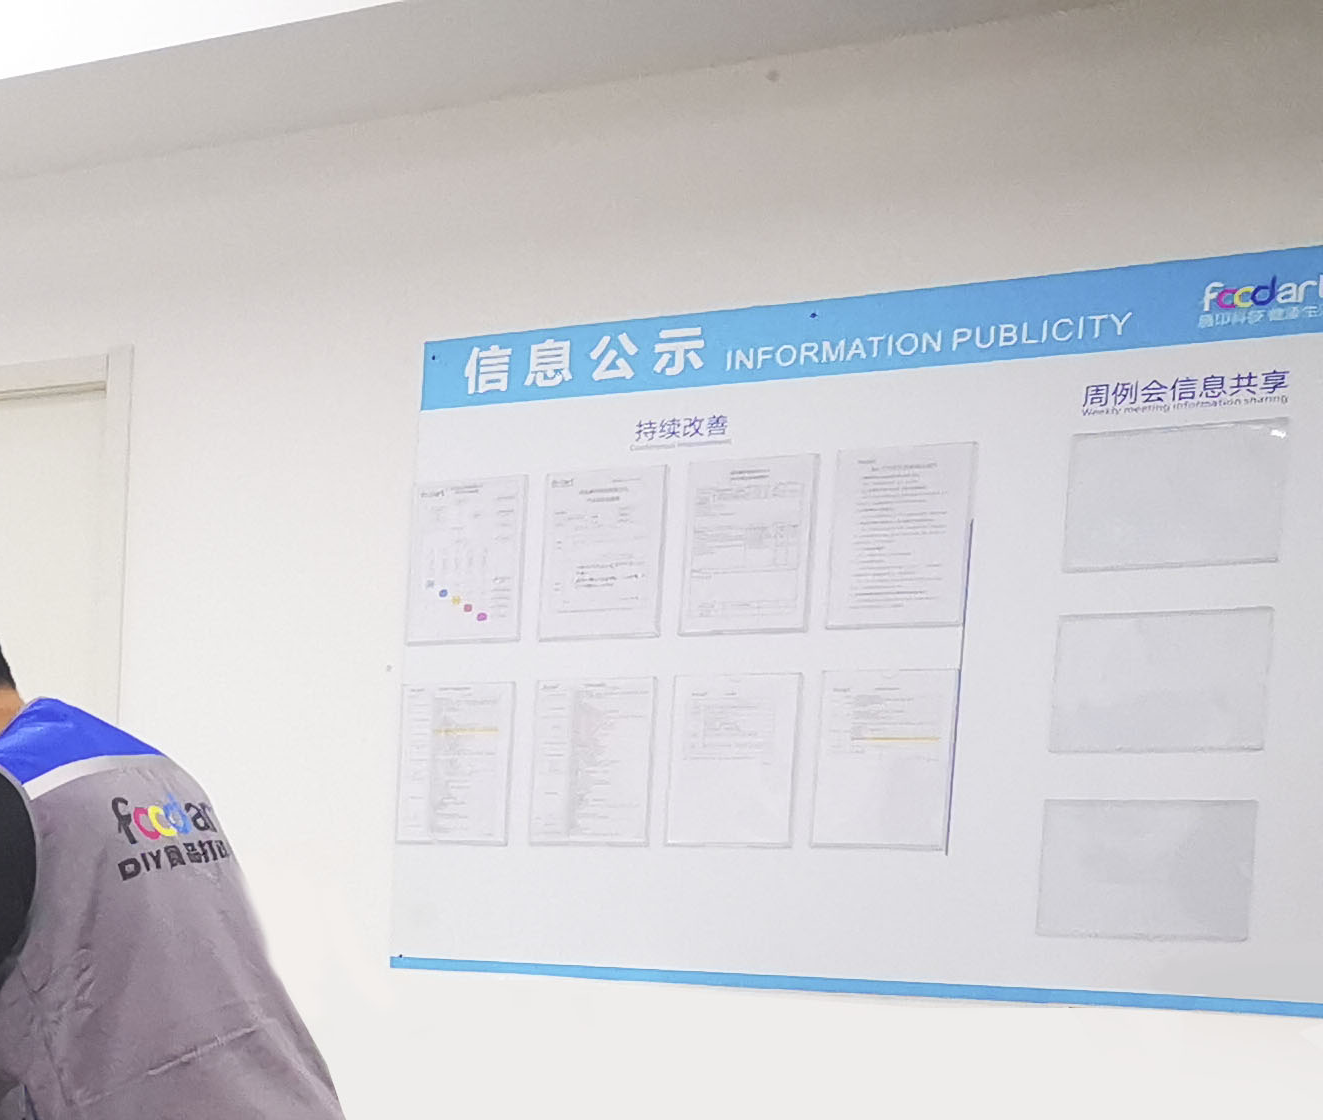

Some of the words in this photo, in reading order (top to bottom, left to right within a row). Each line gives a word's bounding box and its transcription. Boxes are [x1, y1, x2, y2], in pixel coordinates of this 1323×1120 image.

[1202, 274, 1323, 312] foodar
[464, 326, 705, 395] 信息公示
[725, 329, 943, 372] INFORMATION
[951, 311, 1133, 351] PUBLICITY
[1082, 369, 1291, 408] 周例会信息共享
[635, 414, 728, 442] 持续改善
